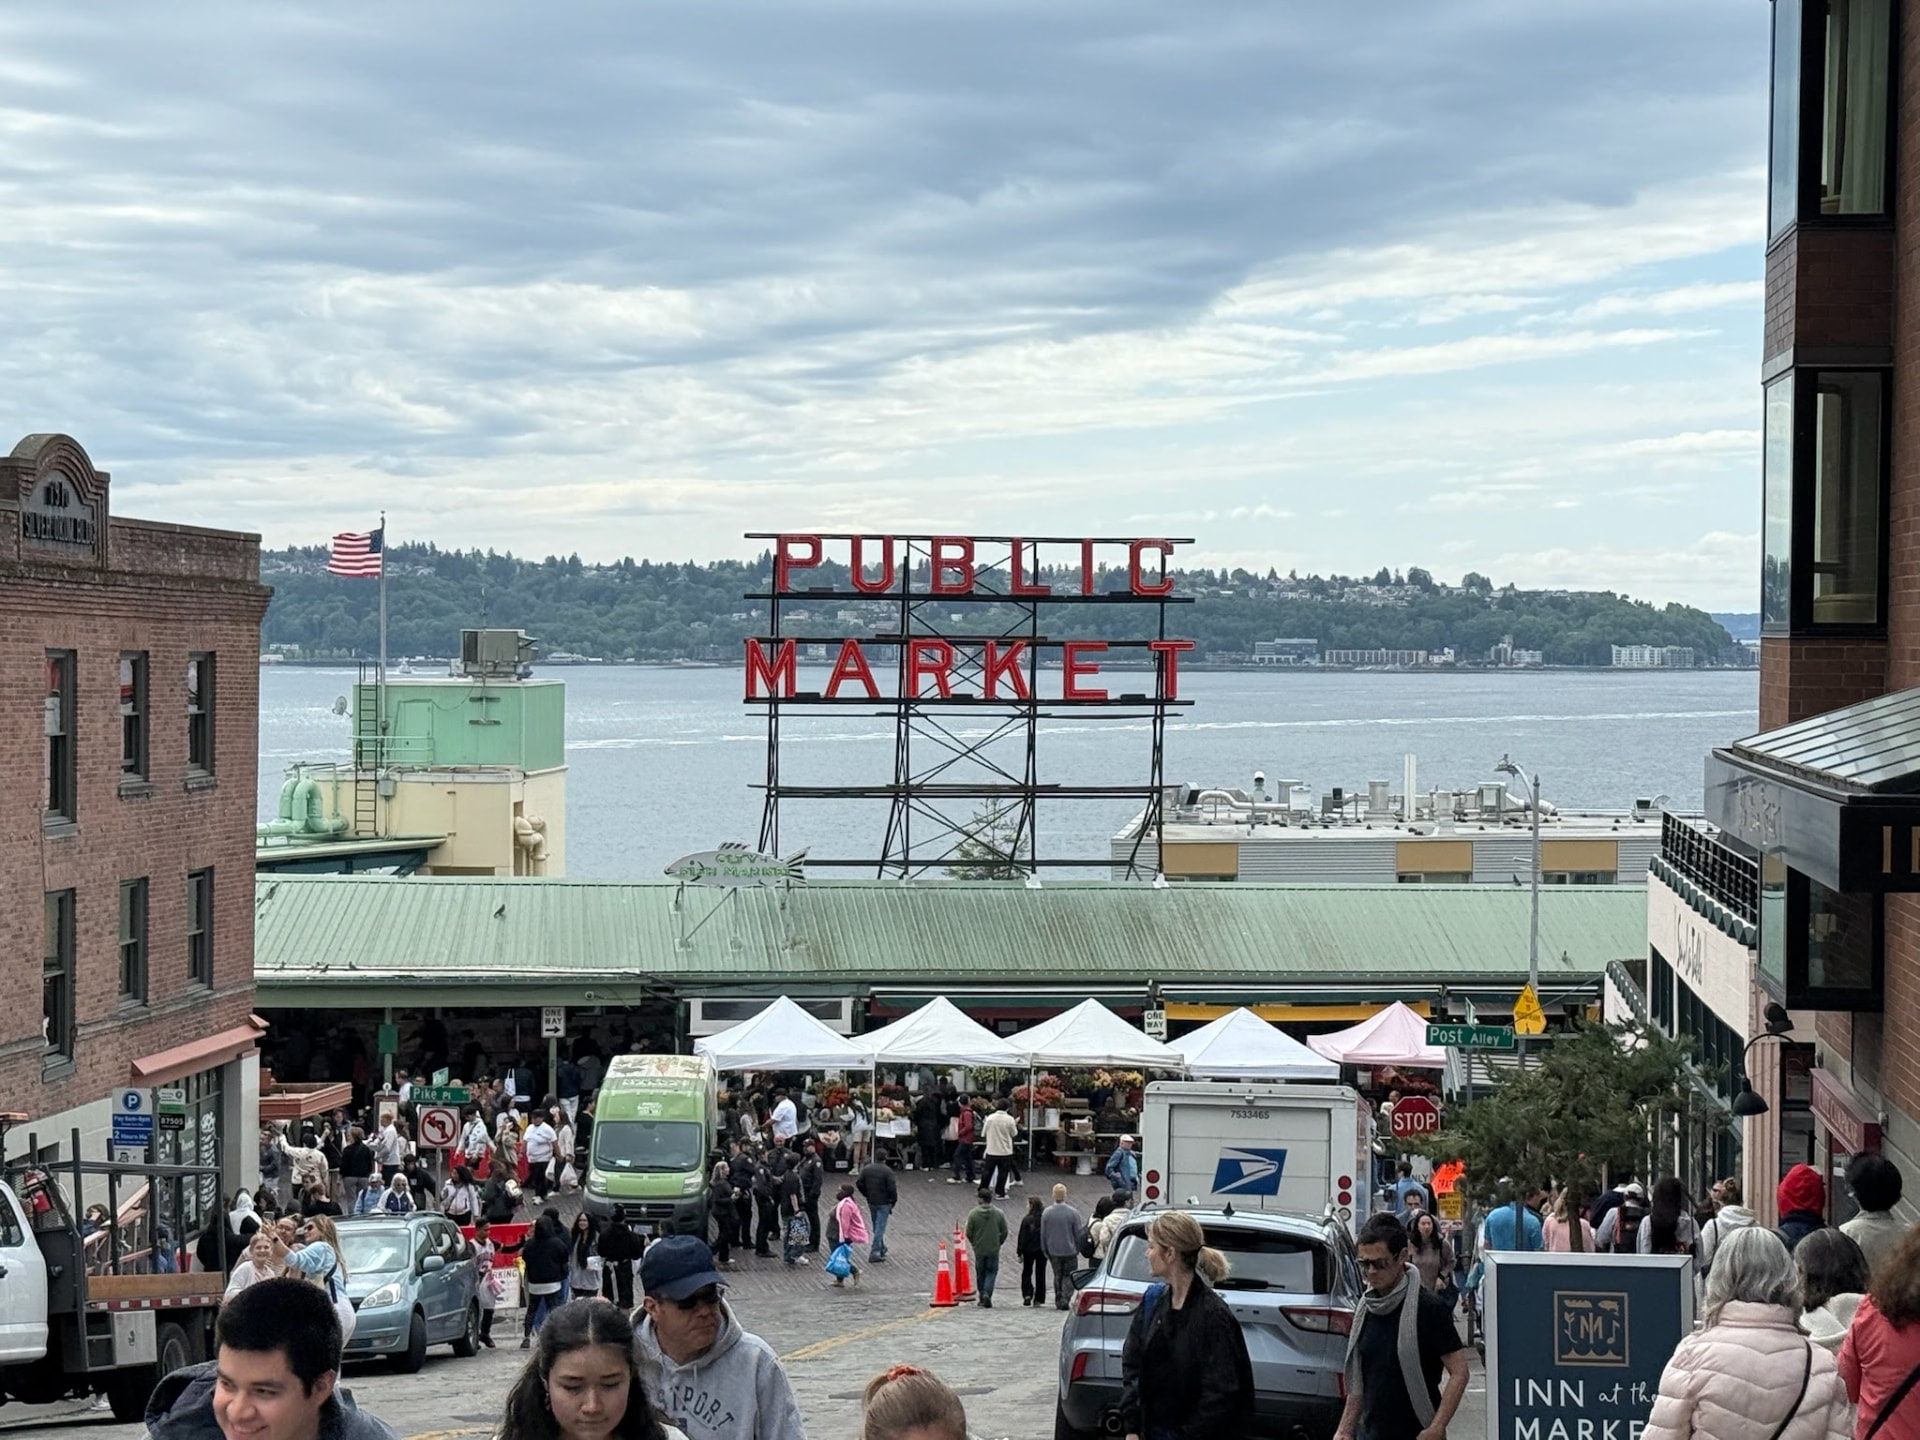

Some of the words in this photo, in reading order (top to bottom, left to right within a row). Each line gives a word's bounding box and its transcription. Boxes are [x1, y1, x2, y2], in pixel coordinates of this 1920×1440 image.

[776, 533, 1175, 596] PUBLIC
[744, 636, 1196, 701] MARKET
[544, 1008, 562, 1017] ONE
[1146, 1012, 1164, 1020] ONE
[544, 1017, 562, 1025] WAY
[1146, 1020, 1164, 1028] WAY
[1430, 1027, 1462, 1043] Post
[1470, 1033, 1500, 1046] Alley
[413, 1087, 437, 1100] Pike
[442, 1091, 452, 1100] Pl
[1230, 1110, 1270, 1119] 7533465
[1394, 1112, 1436, 1130] STOP
[114, 1131, 120, 1139] 2
[493, 1269, 518, 1278] RKING
[1514, 1378, 1584, 1408] INN
[1598, 1382, 1624, 1405] at
[1514, 1416, 1645, 1440] MARKE
